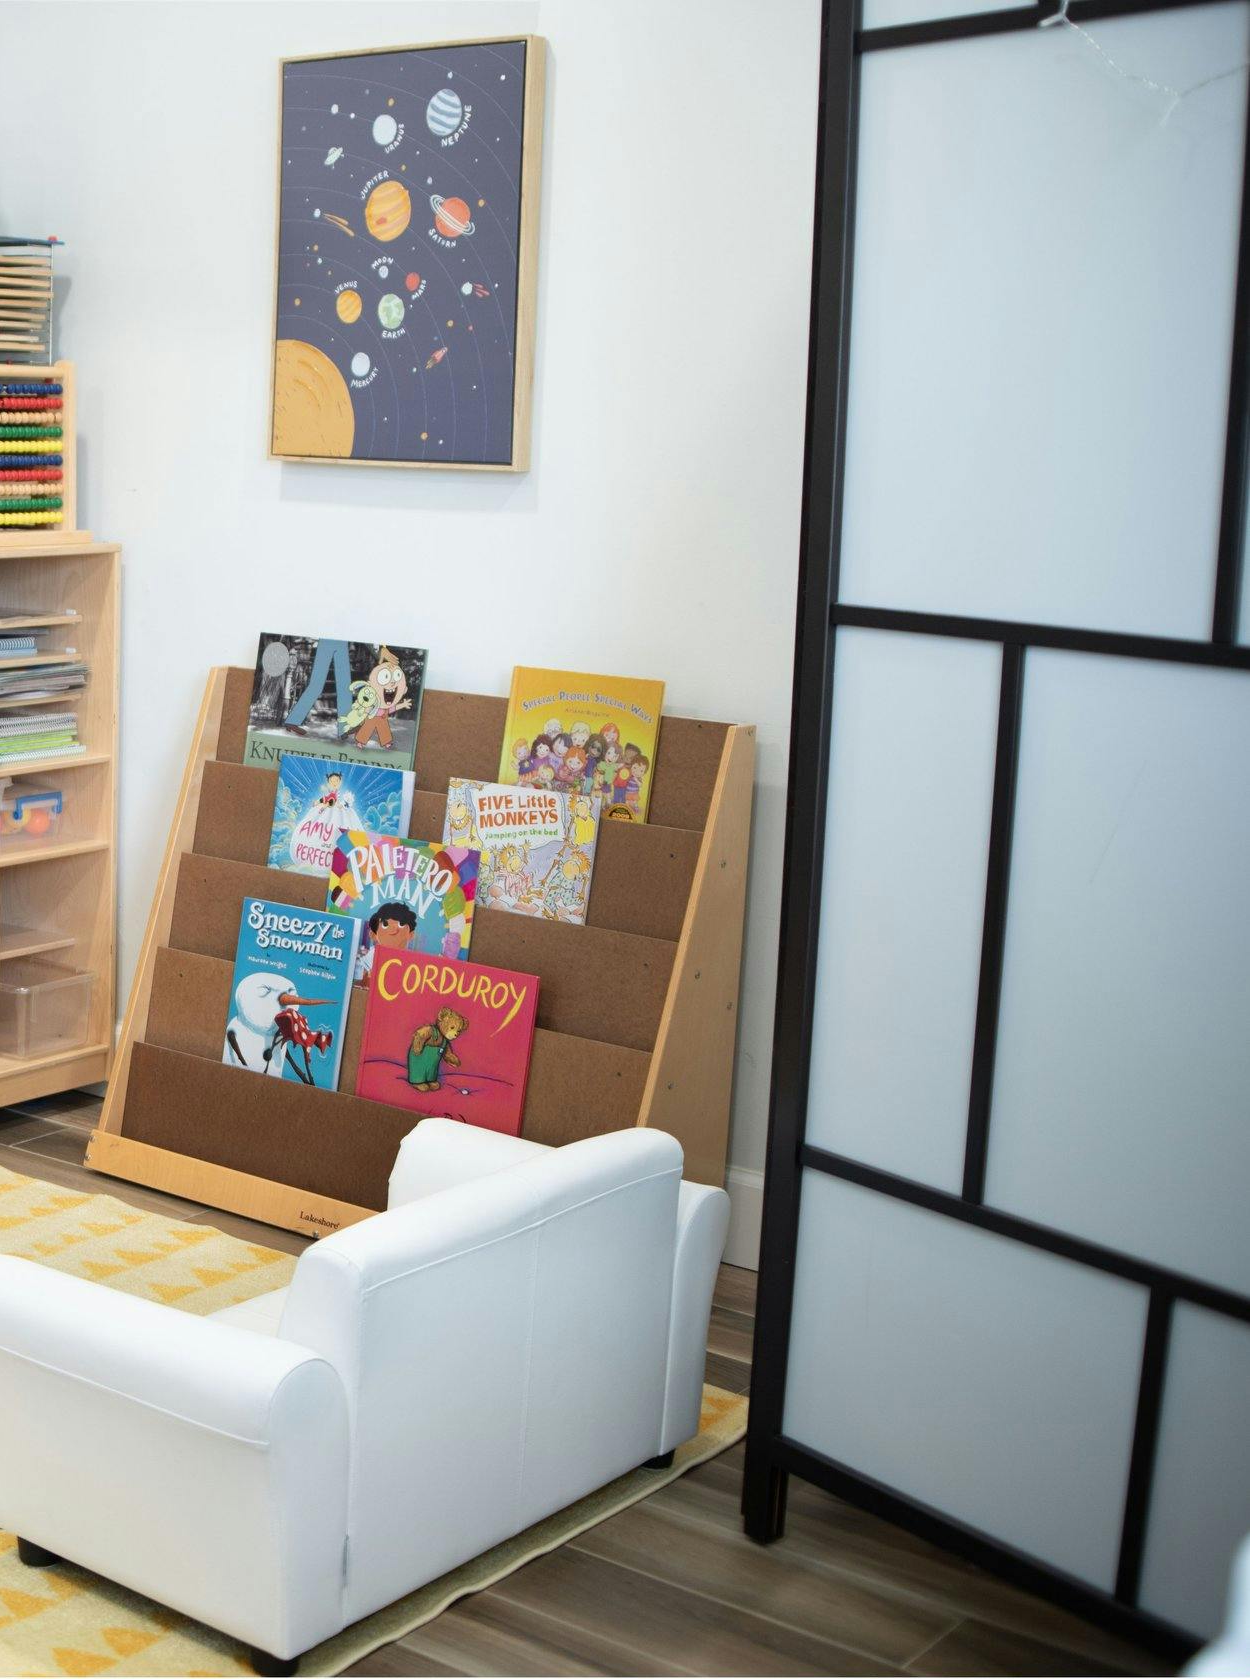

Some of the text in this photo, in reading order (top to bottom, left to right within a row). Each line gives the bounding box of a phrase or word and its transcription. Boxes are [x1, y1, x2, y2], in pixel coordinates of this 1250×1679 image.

[440, 104, 472, 147] NEPTUNE
[385, 123, 405, 154] URANUS
[361, 170, 389, 200] JUPITER
[429, 228, 457, 248] SATURN
[371, 256, 394, 269] MOON
[335, 280, 358, 294] VENUS
[412, 279, 427, 300] MARS
[382, 328, 406, 339] EARTH
[351, 367, 379, 388] MERCURY
[478, 795, 557, 811] FIVE Little
[479, 809, 558, 828] MONKEYS
[299, 820, 334, 842] AMY
[485, 831, 516, 840] jumping
[296, 843, 334, 867] PERFEC
[346, 844, 453, 901] PALETERO
[370, 872, 443, 919] MAN
[248, 901, 346, 943] Sneezy the
[256, 928, 343, 961] Snowman
[377, 958, 527, 1038] CORDUROY
[300, 1211, 339, 1229] Lakeshore
